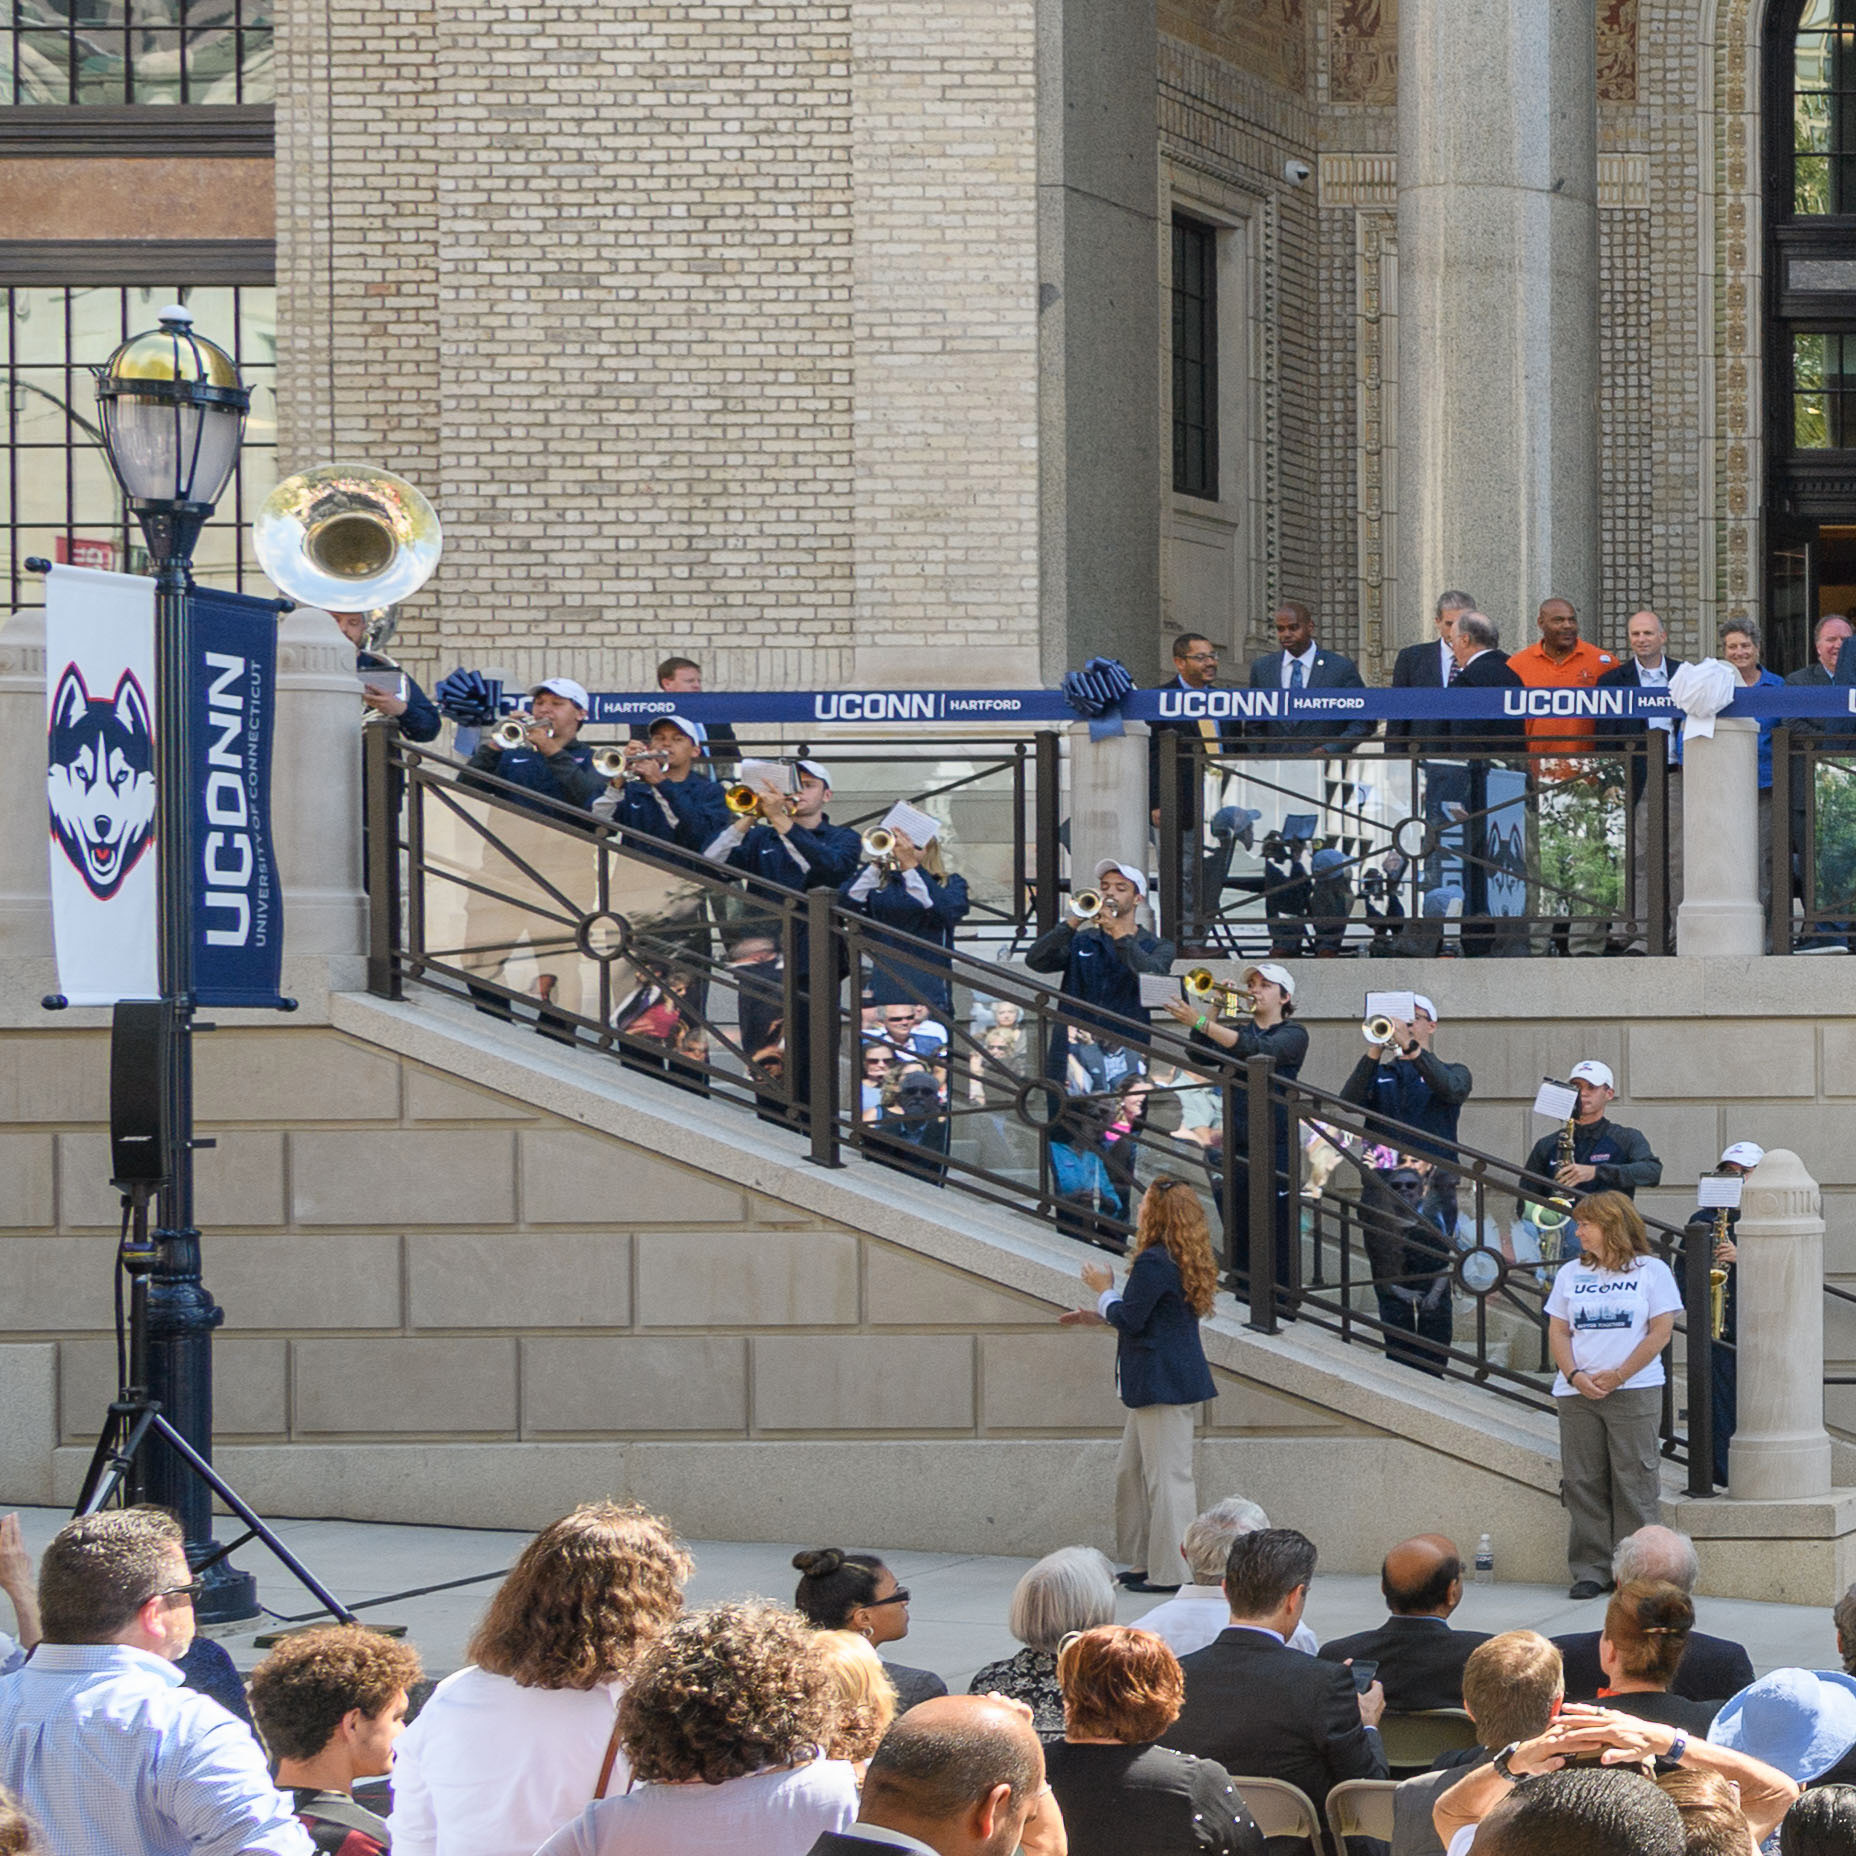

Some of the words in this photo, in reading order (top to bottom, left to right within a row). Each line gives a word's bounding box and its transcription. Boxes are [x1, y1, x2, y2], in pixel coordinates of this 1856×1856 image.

[603, 701, 676, 713] HARTFORD
[814, 692, 935, 720] UCONN
[949, 699, 1022, 711] HARTFORD
[1158, 690, 1280, 718] UCONN
[1293, 697, 1365, 710] HARTFORD
[1503, 688, 1624, 716] UCONN
[1637, 696, 1677, 709] HART
[248, 659, 262, 800] CONNECTICUT
[204, 651, 254, 947] UCONN
[251, 802, 263, 832] OF
[254, 833, 269, 948] UNIVERSITY
[1574, 1281, 1638, 1294] UCONN
